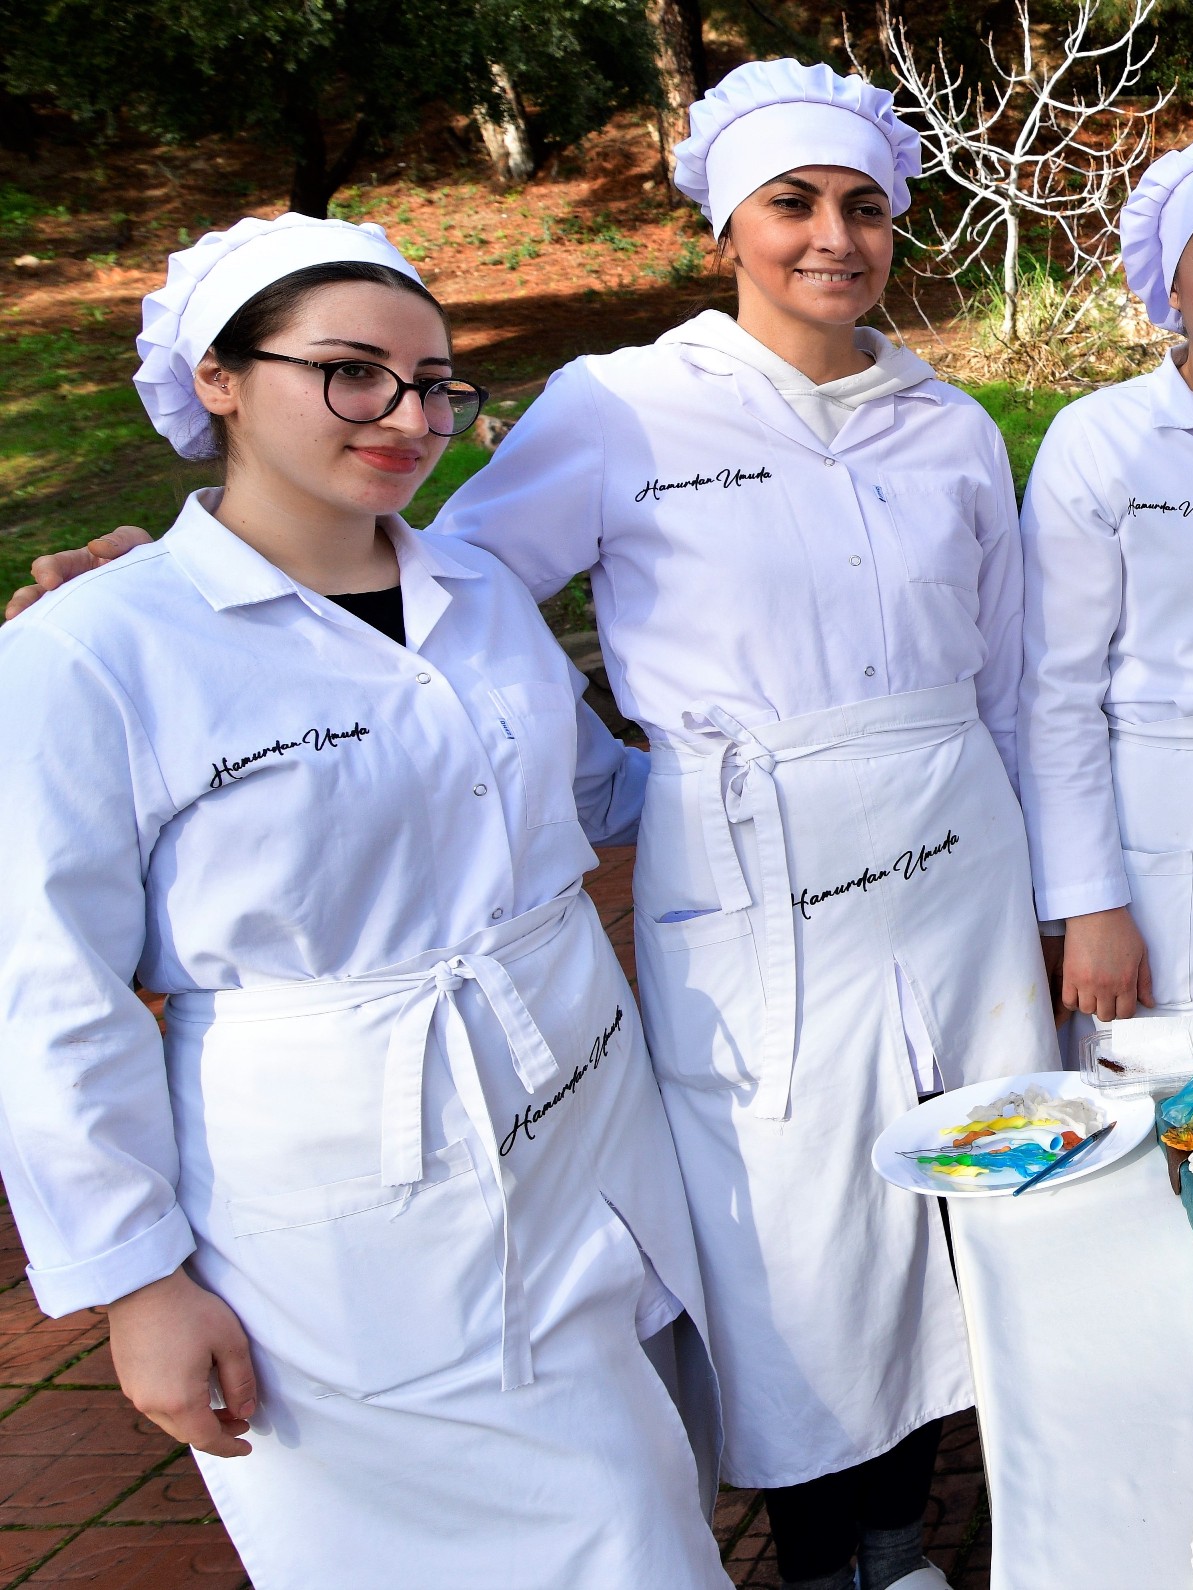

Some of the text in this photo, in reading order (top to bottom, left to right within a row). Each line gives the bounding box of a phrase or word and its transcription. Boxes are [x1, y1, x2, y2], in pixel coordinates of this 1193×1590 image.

[635, 467, 772, 502] Hamurdan Umuda
[1127, 497, 1177, 518] Hamurdan
[210, 722, 370, 788] Hamurdan Umuda
[790, 829, 960, 920] Hamurdan Umuda
[499, 1004, 623, 1157] Hamurdan Umuda
